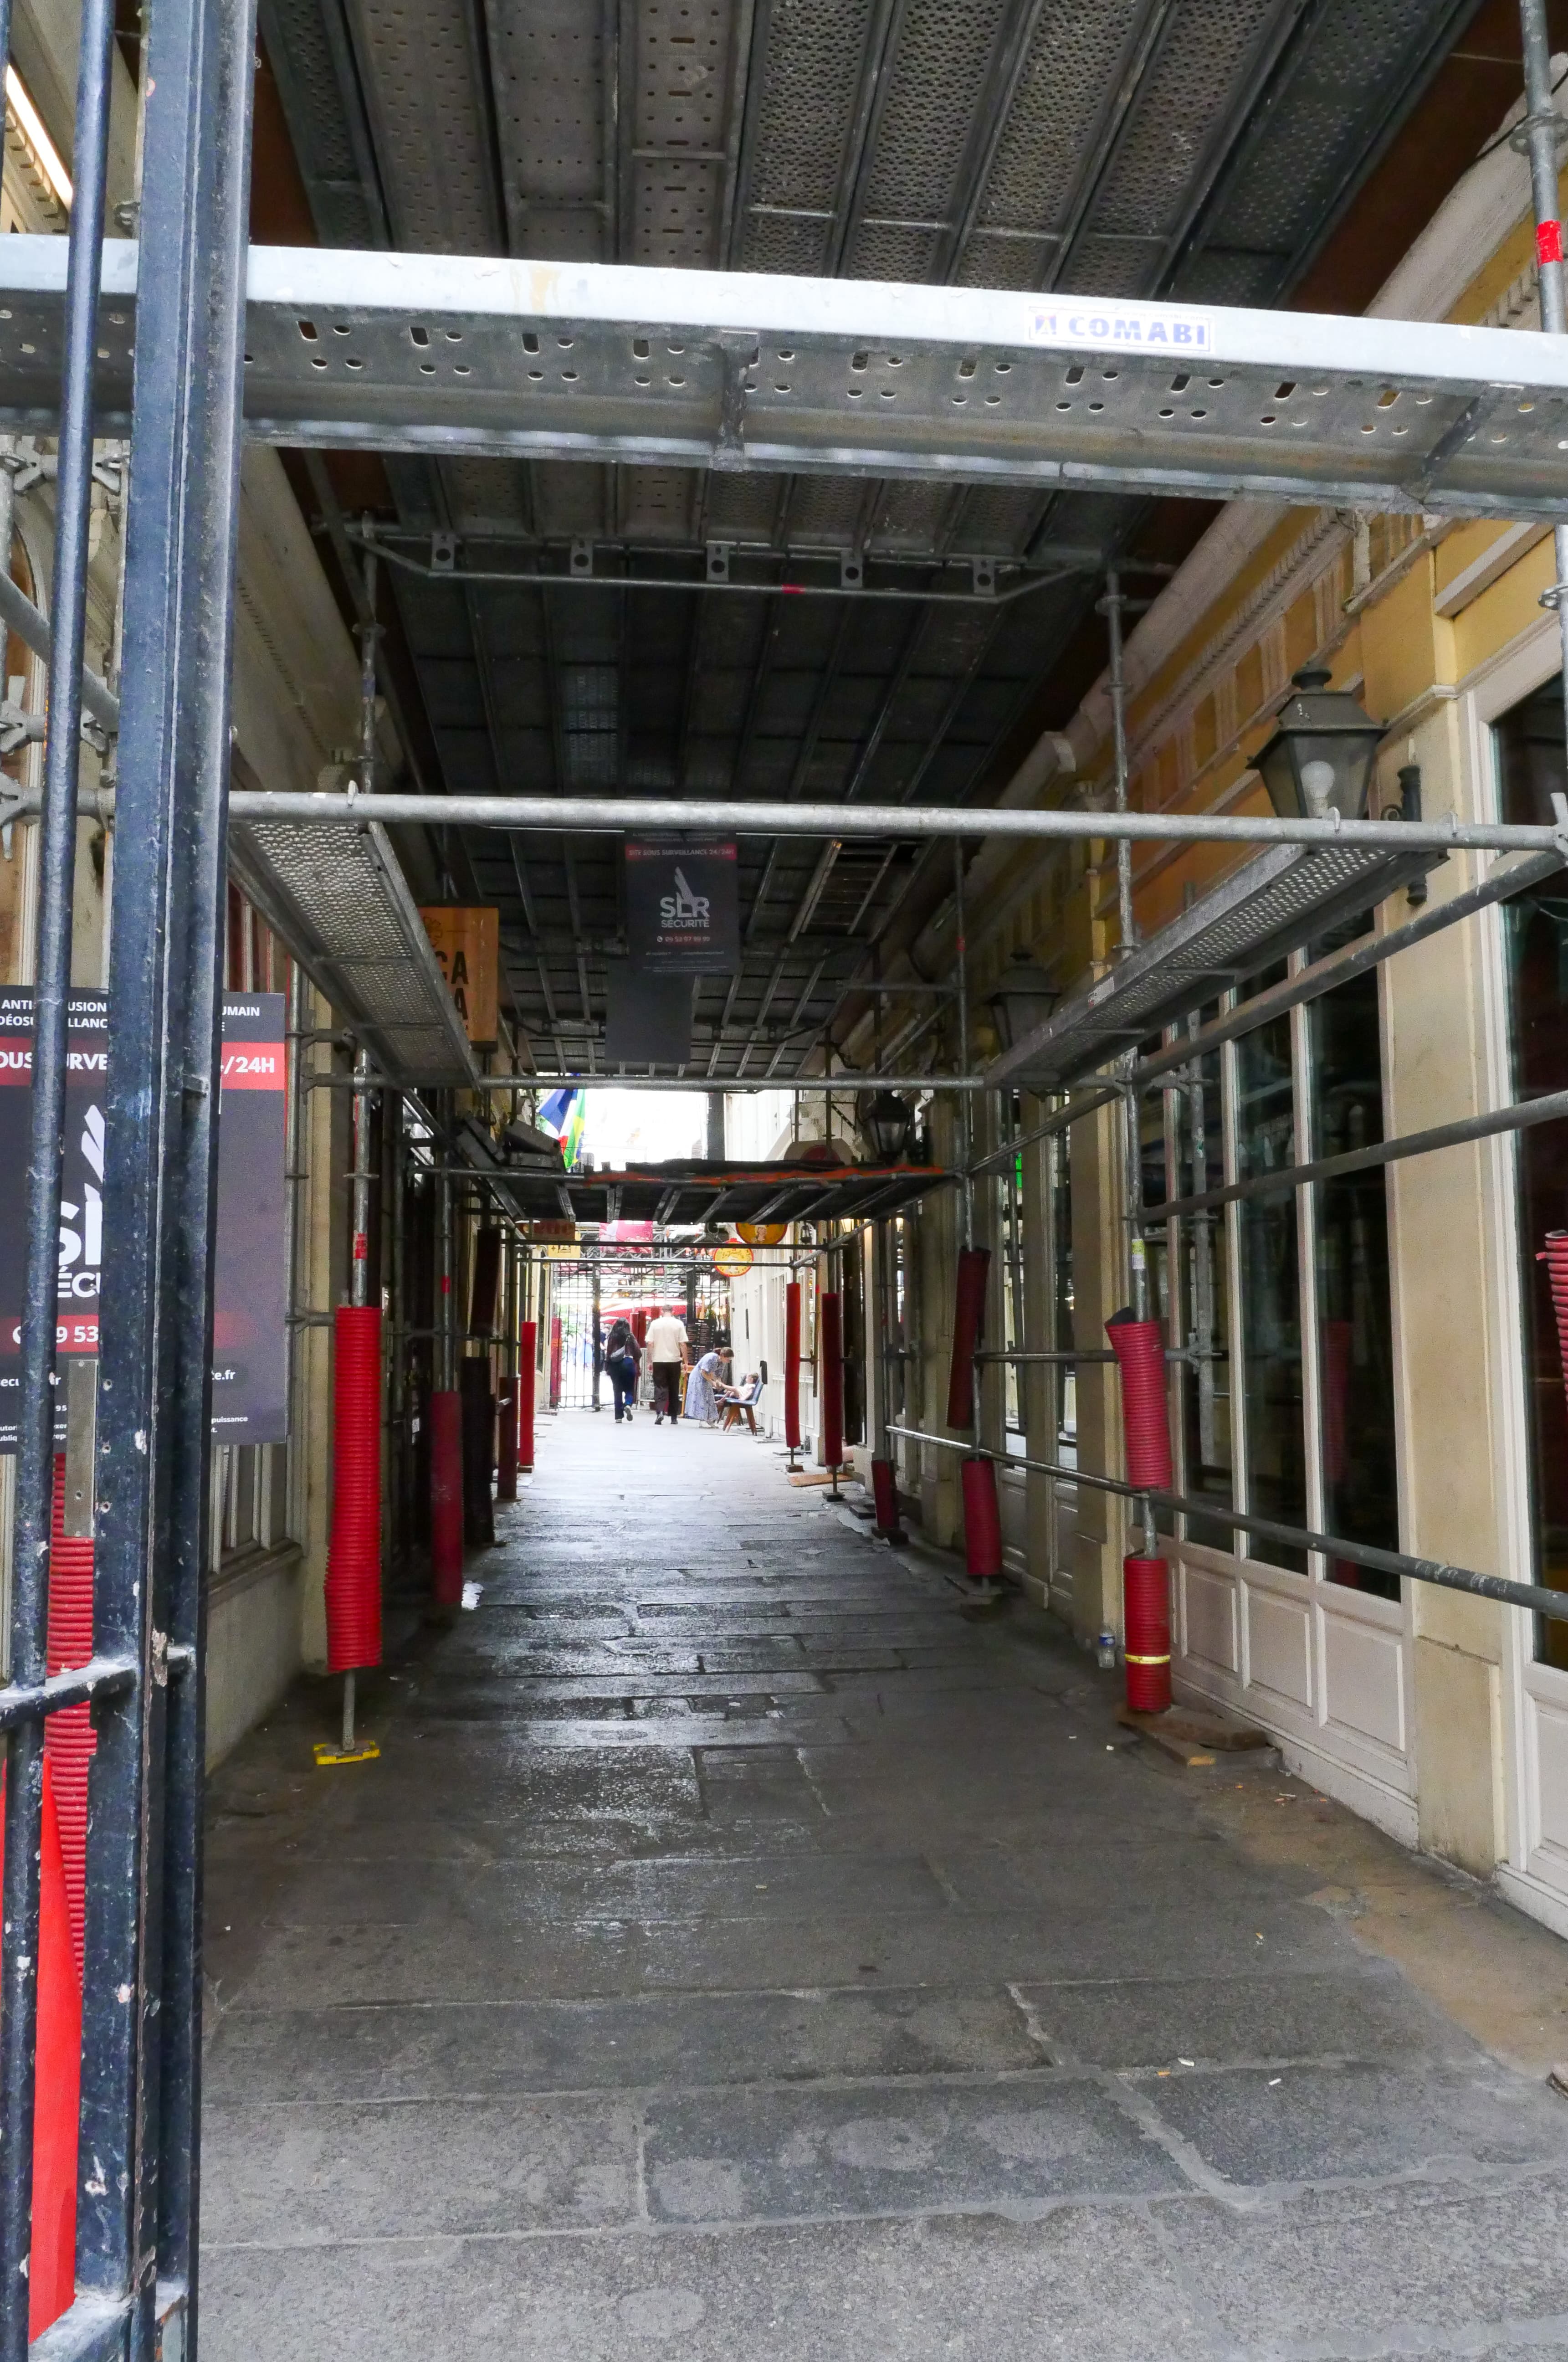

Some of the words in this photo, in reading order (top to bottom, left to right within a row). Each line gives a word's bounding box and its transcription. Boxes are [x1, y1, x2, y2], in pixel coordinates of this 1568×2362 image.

[1069, 317, 1204, 344] COMABI
[660, 897, 710, 918] SLR
[661, 918, 709, 927] SÉCURITÉ
[220, 1056, 274, 1074] /24H
[74, 1326, 98, 1343] 53
